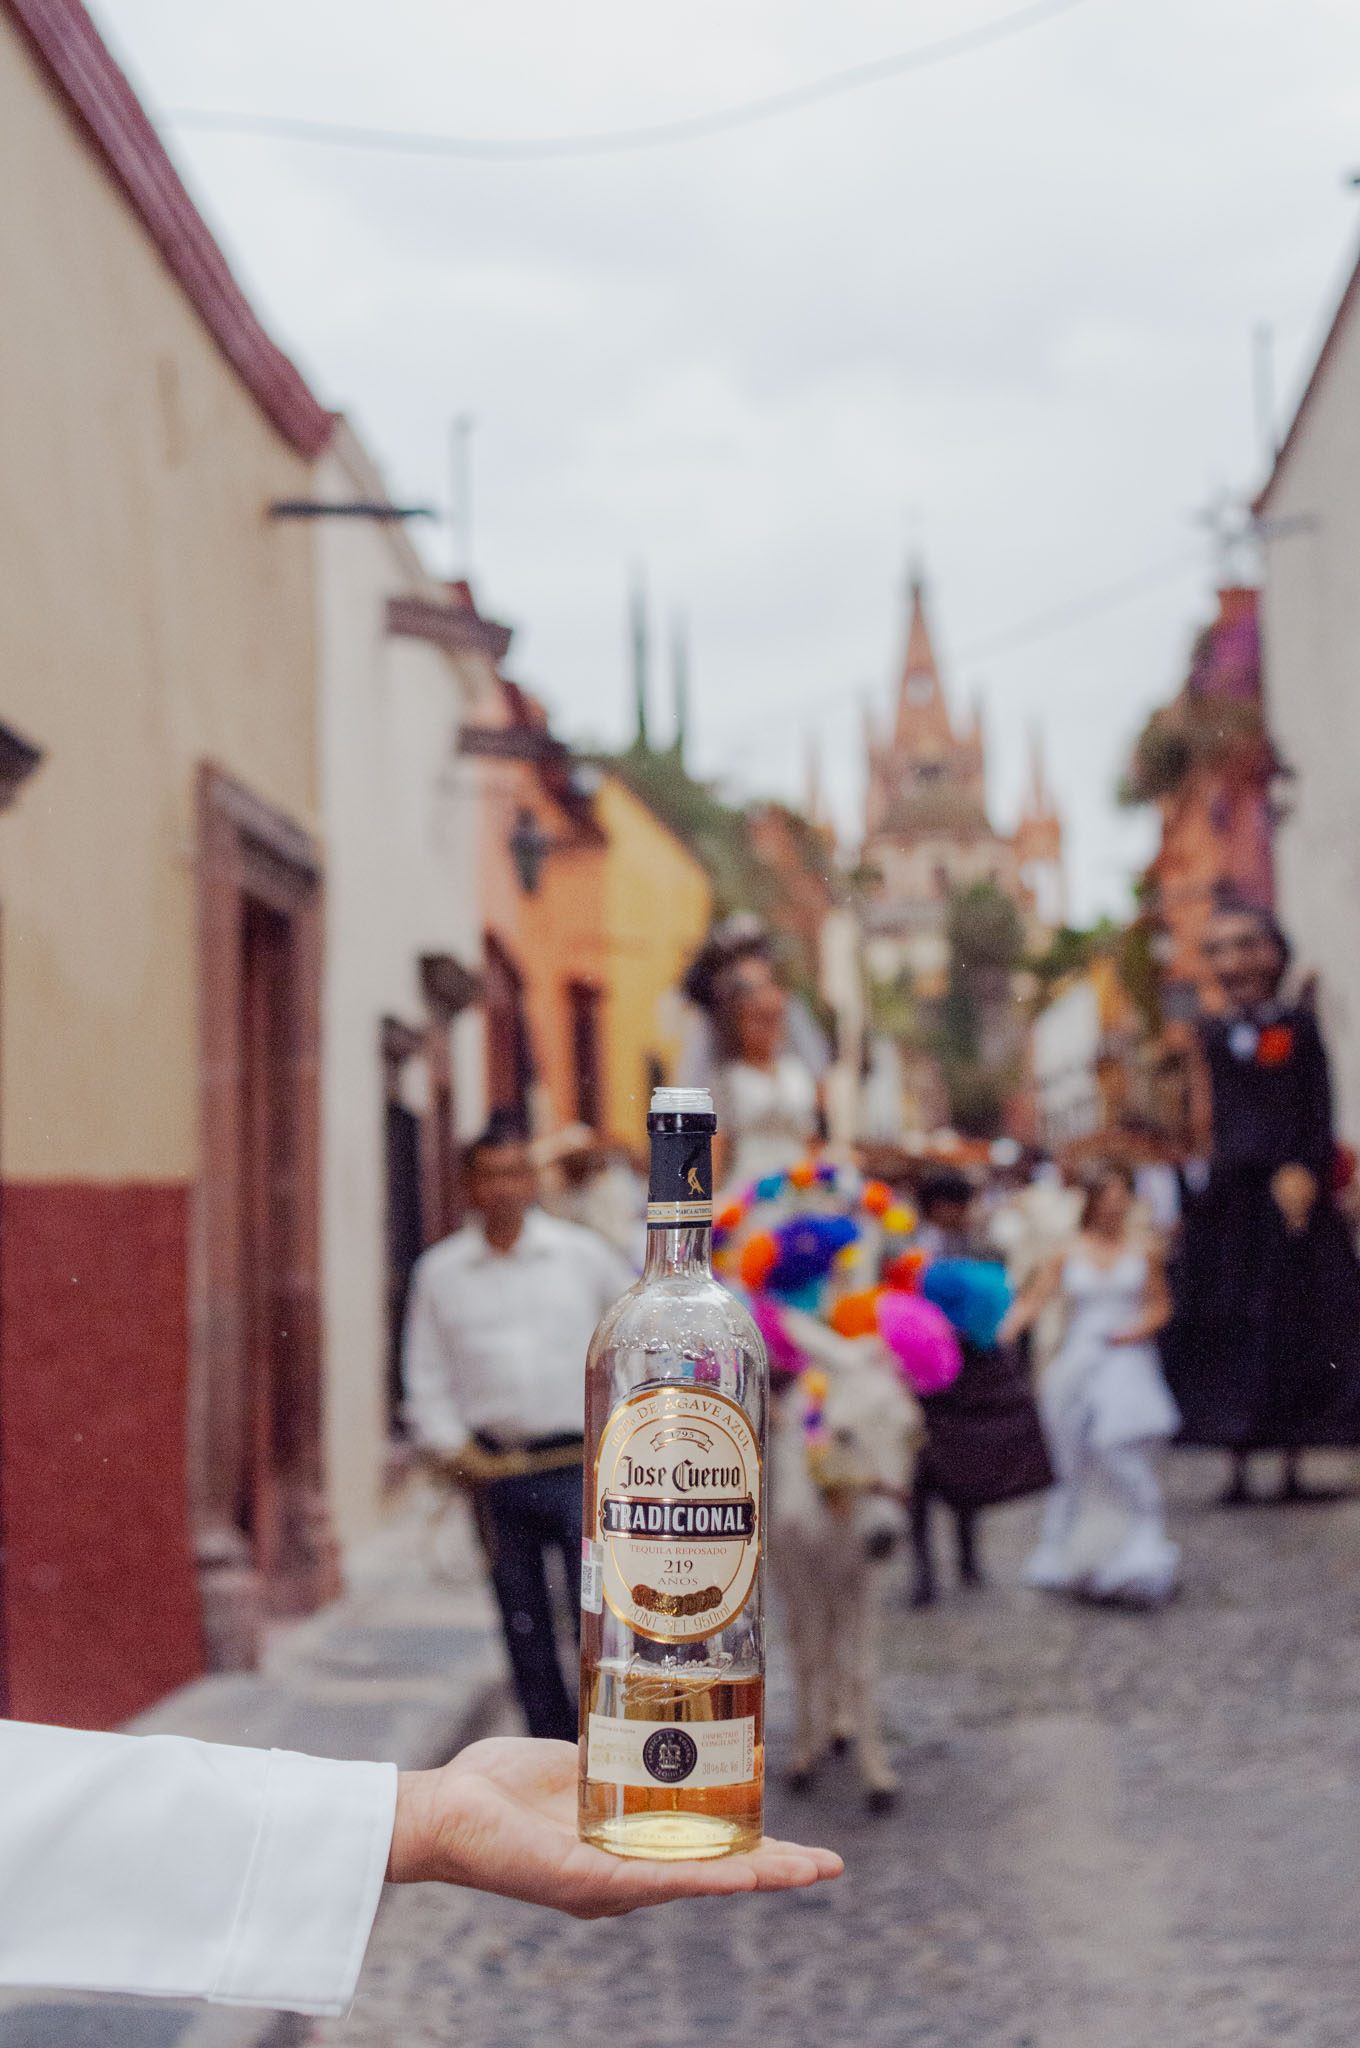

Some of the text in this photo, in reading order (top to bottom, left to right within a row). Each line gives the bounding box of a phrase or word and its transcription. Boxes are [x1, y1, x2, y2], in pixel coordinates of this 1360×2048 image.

[637, 1402, 660, 1419] DE
[664, 1398, 721, 1417] AGAVE
[722, 1414, 750, 1451] AZUL
[670, 1429, 695, 1439] 1795
[619, 1455, 741, 1493] Jose Cuervo
[609, 1502, 745, 1532] TRADICIONAL
[631, 1544, 728, 1555] TEQUILA REPOSADO
[663, 1559, 694, 1574] 219
